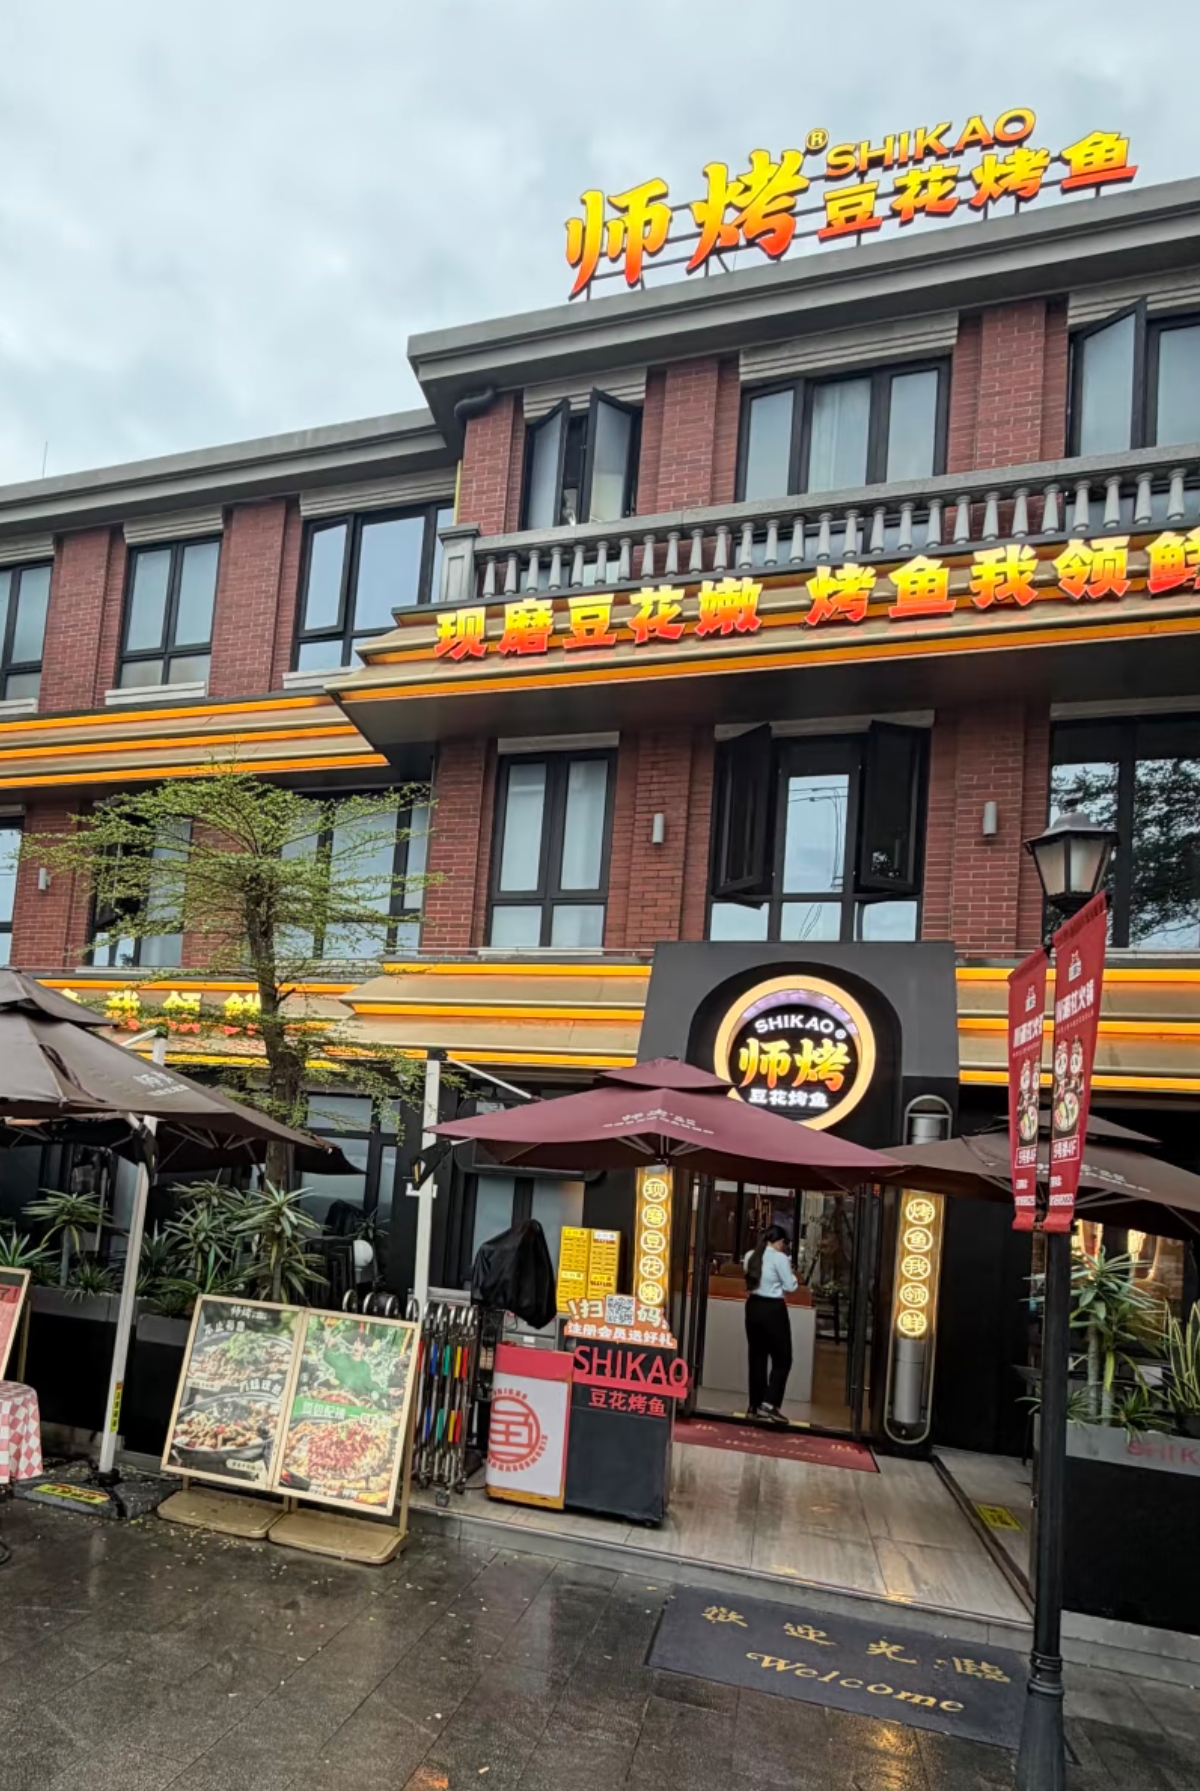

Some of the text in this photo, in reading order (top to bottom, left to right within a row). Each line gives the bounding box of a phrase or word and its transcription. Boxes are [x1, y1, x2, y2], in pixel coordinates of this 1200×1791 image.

[825, 107, 1036, 176] SHIKAO
[817, 131, 1137, 240] 豆花烤鱼
[565, 148, 809, 299] 师烤
[434, 576, 763, 661] 现磨豆花嫩
[754, 1014, 835, 1033] SHIKAO
[738, 1037, 851, 1092] 师烤
[748, 1087, 829, 1108] 豆花烤鱼
[574, 1345, 690, 1388] SHIKAO
[588, 1388, 666, 1417] 豆花烤鱼
[745, 1652, 965, 1713] Welcome
